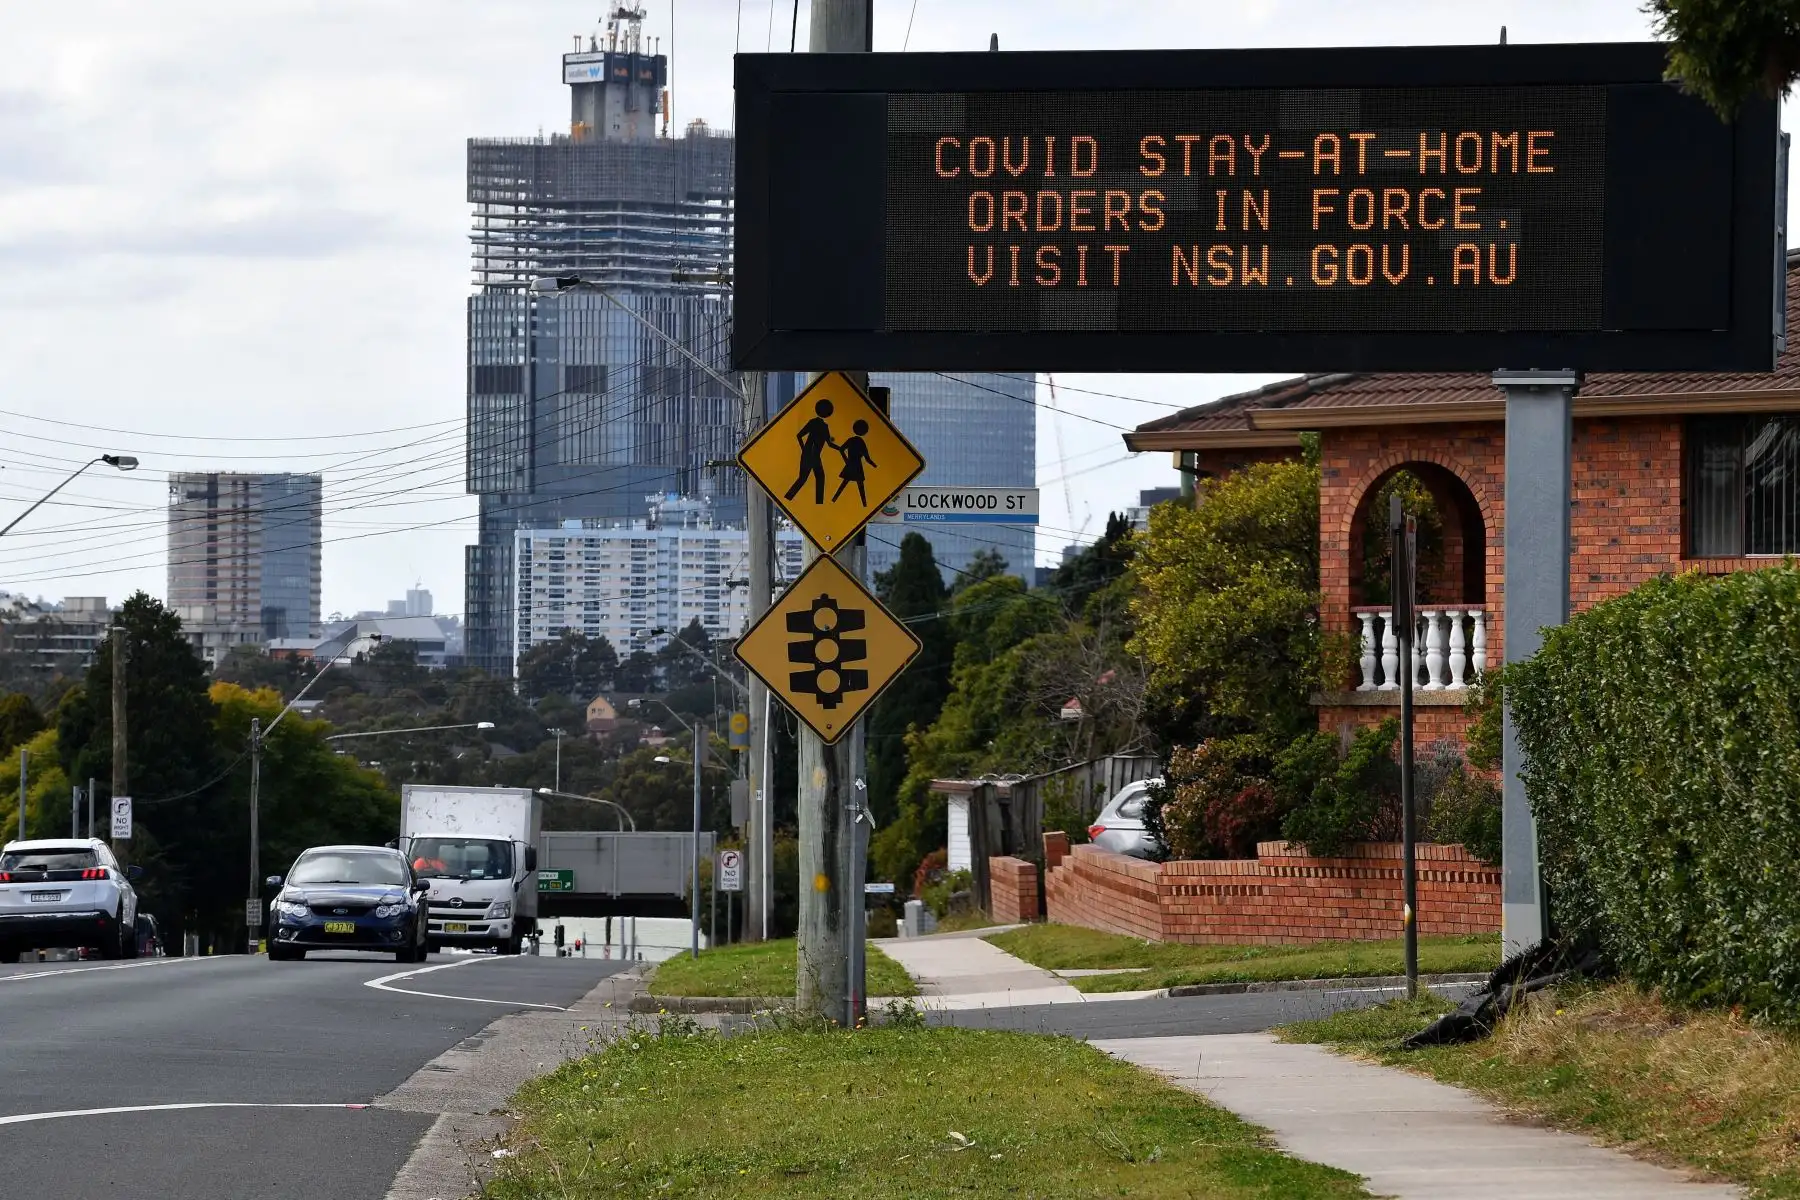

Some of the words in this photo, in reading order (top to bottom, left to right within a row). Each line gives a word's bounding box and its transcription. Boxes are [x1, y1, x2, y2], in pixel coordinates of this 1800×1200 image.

[935, 136, 1097, 177] COVID
[1139, 131, 1555, 177] STAY-AT-HOME
[968, 189, 1166, 232] ORDERS
[1215, 189, 1269, 231] IN
[1311, 187, 1509, 230] FORCE.
[967, 244, 1130, 287] VISIT
[1172, 242, 1517, 287] NSW.GOV.AU
[907, 494, 998, 509] LOCKWOOD
[1005, 495, 1026, 510] ST
[907, 513, 946, 521] MERRYLANDS
